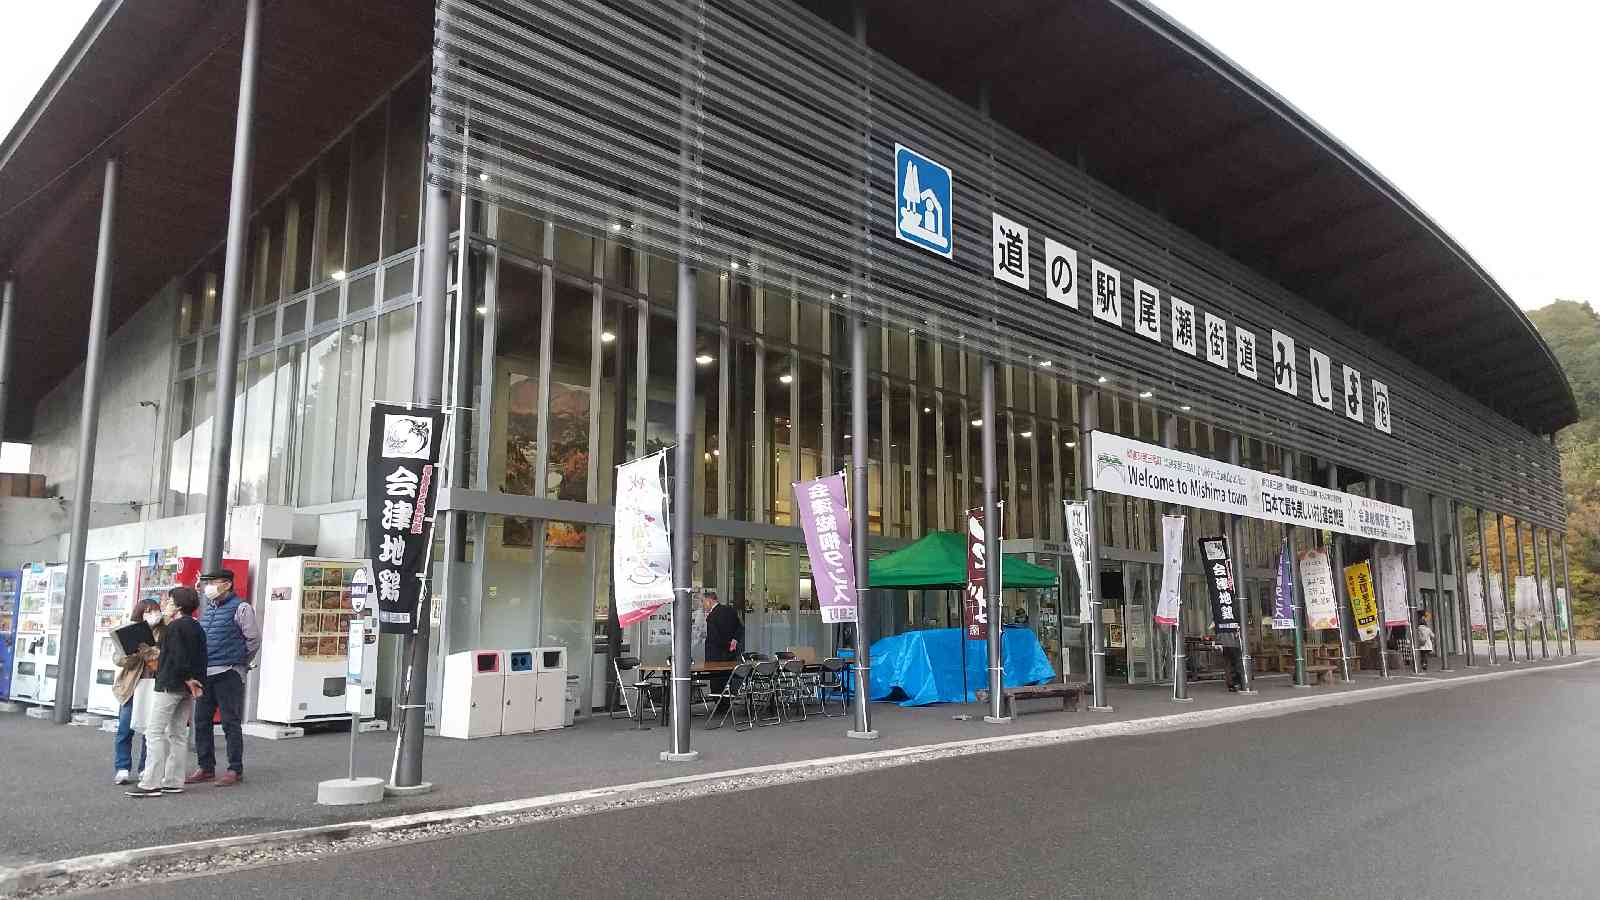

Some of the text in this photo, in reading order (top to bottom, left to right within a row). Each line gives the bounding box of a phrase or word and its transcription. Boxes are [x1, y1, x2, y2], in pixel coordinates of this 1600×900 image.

[1127, 465, 1175, 492] Welcome
[1177, 478, 1188, 495] to
[1190, 478, 1226, 503] Mishima
[1228, 489, 1248, 507] town
[378, 465, 419, 602] 会津地鶏
